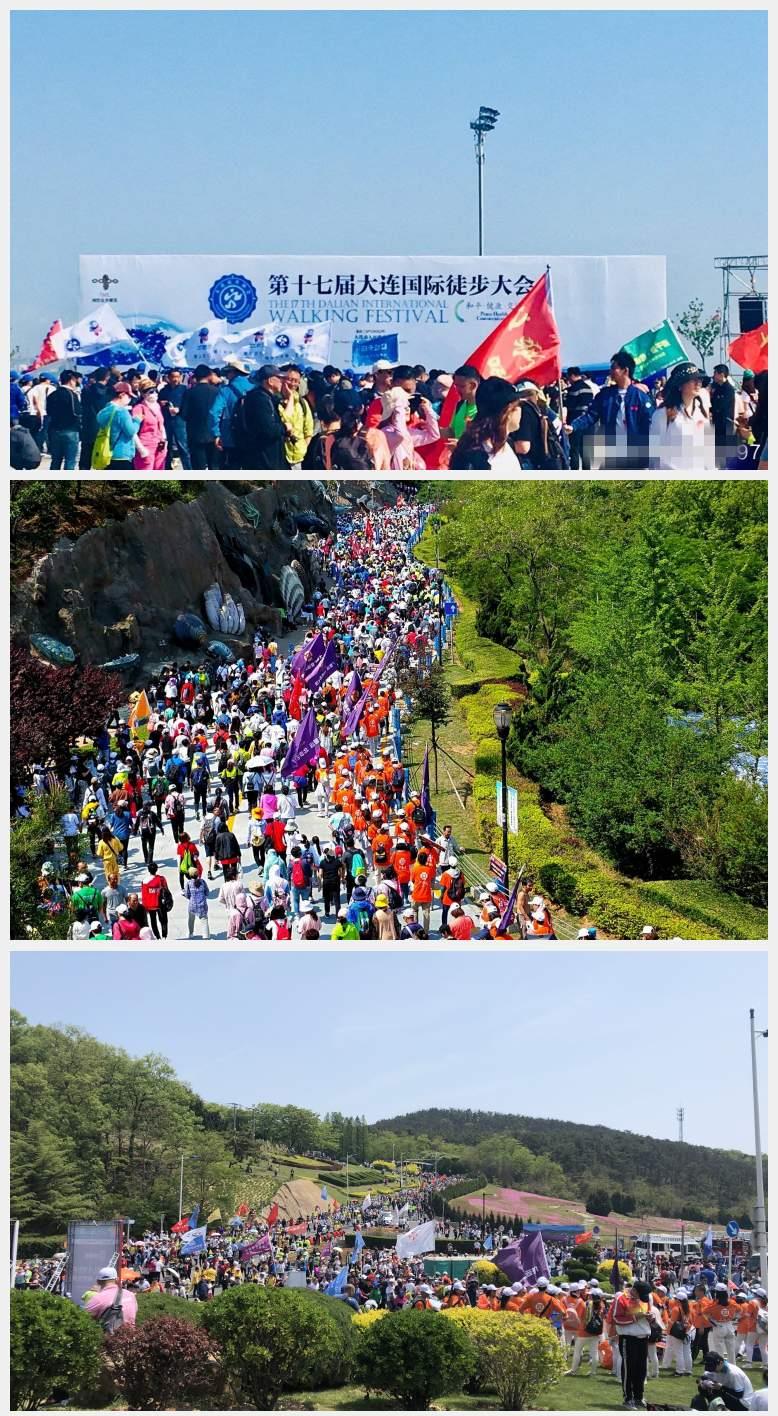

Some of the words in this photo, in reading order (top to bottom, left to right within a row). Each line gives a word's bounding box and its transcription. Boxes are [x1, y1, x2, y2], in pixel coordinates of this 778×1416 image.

[268, 274, 535, 296] 第十七届大连国际徒步大会
[318, 299, 359, 309] DALIAN
[362, 299, 448, 309] INTERNATIONAL
[269, 309, 359, 323] WALKING
[365, 309, 449, 324] FESTIVAL
